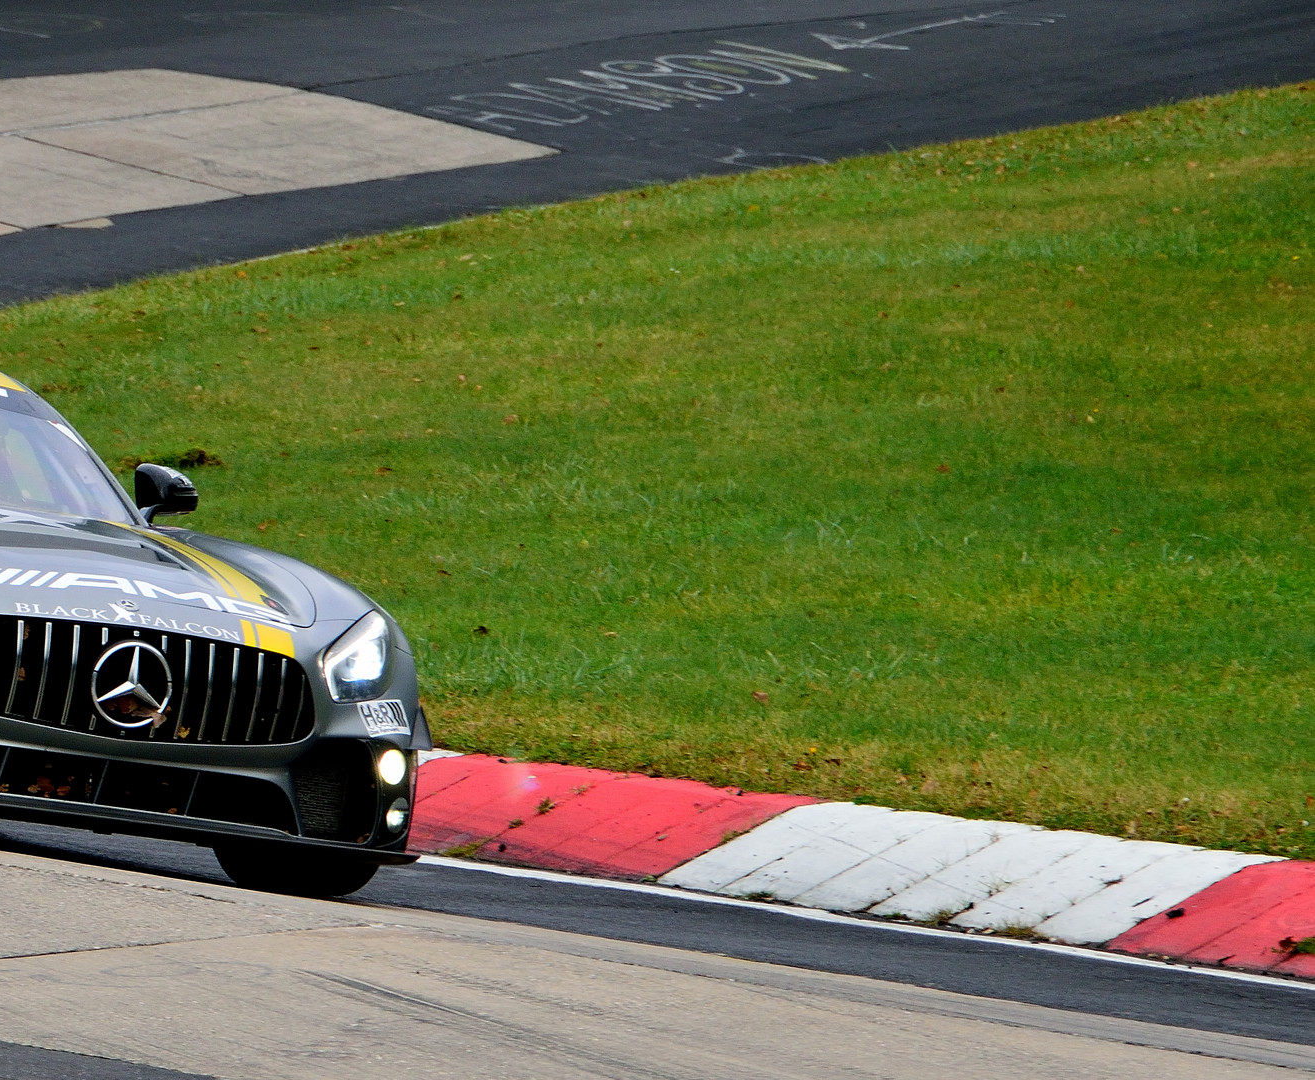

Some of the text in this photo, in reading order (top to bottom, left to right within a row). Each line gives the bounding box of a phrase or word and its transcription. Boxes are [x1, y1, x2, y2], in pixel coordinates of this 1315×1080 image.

[15, 602, 241, 642] BLACK FALCON
[48, 572, 298, 634] AMG
